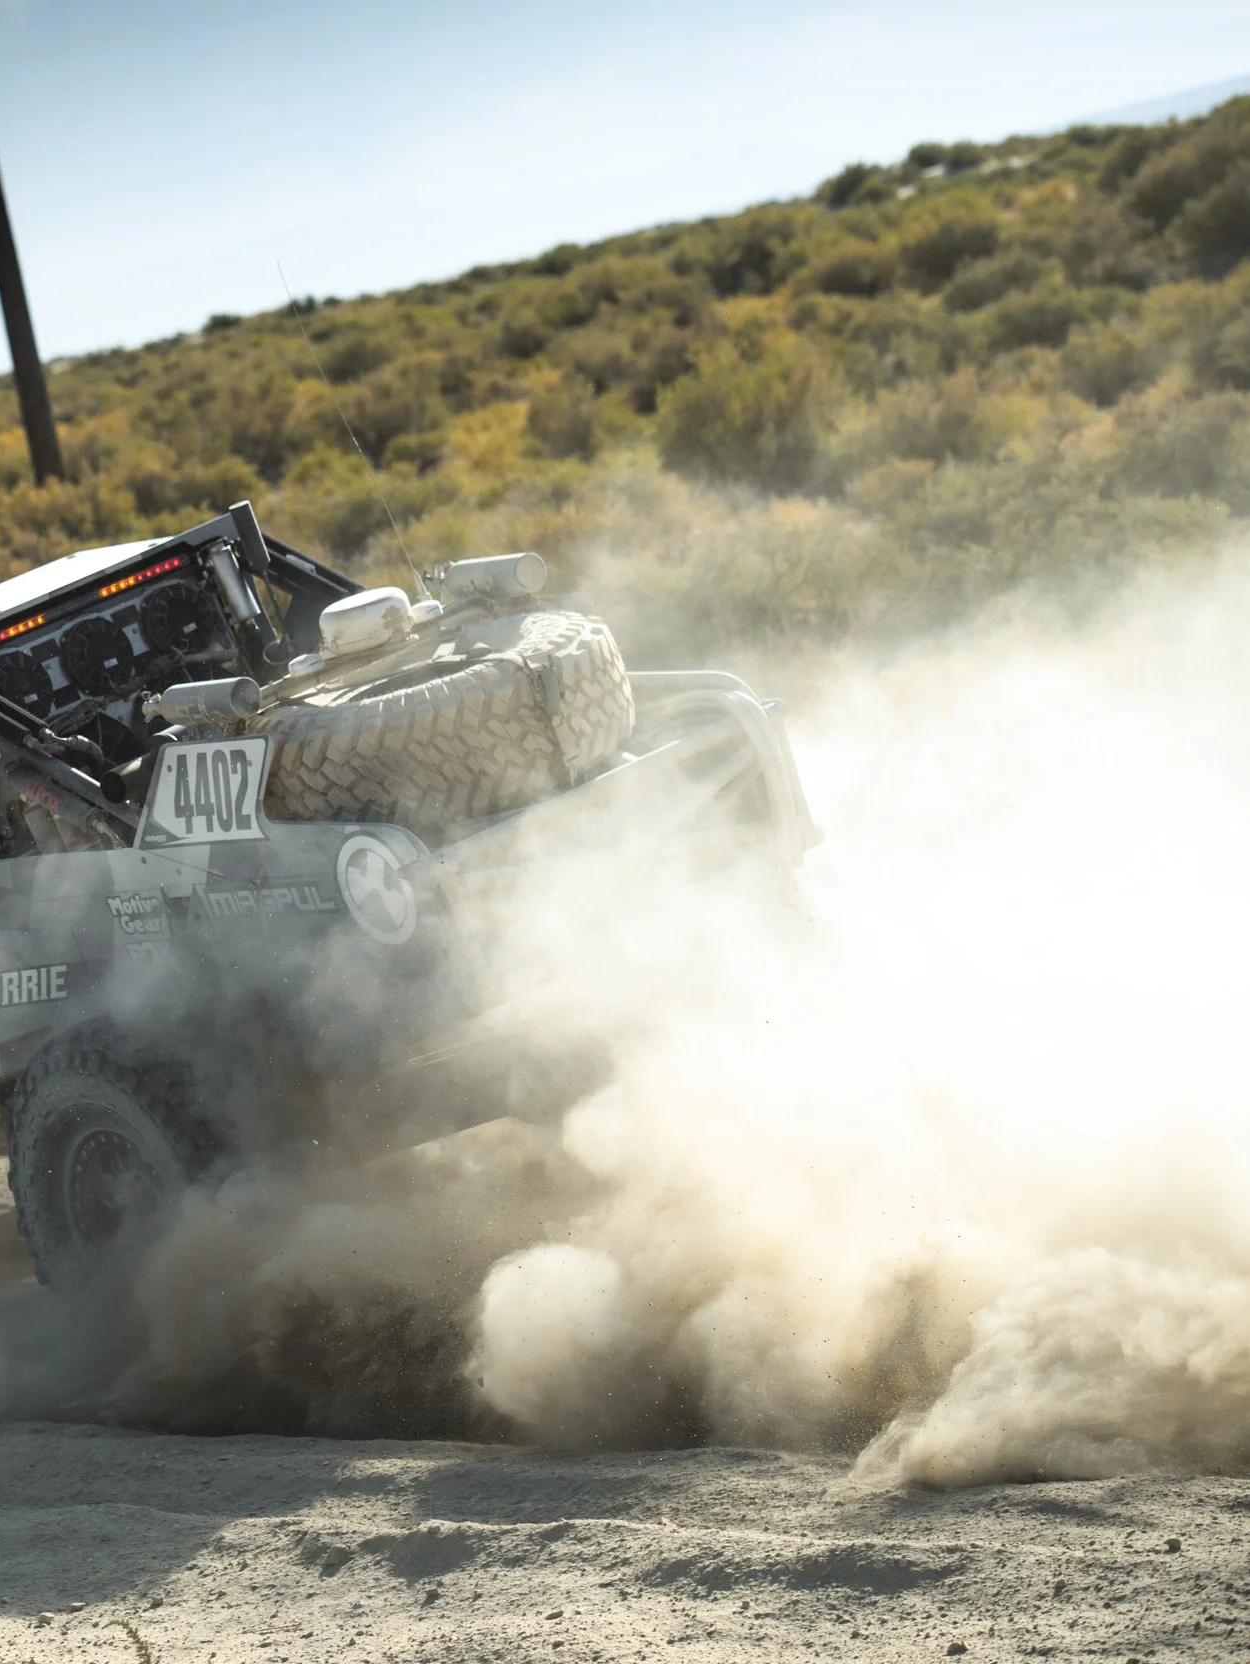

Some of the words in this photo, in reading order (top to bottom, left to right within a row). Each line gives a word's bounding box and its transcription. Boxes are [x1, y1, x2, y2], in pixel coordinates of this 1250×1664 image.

[174, 749, 252, 834] 4402
[107, 894, 162, 916] Motive
[120, 914, 162, 935] Gear
